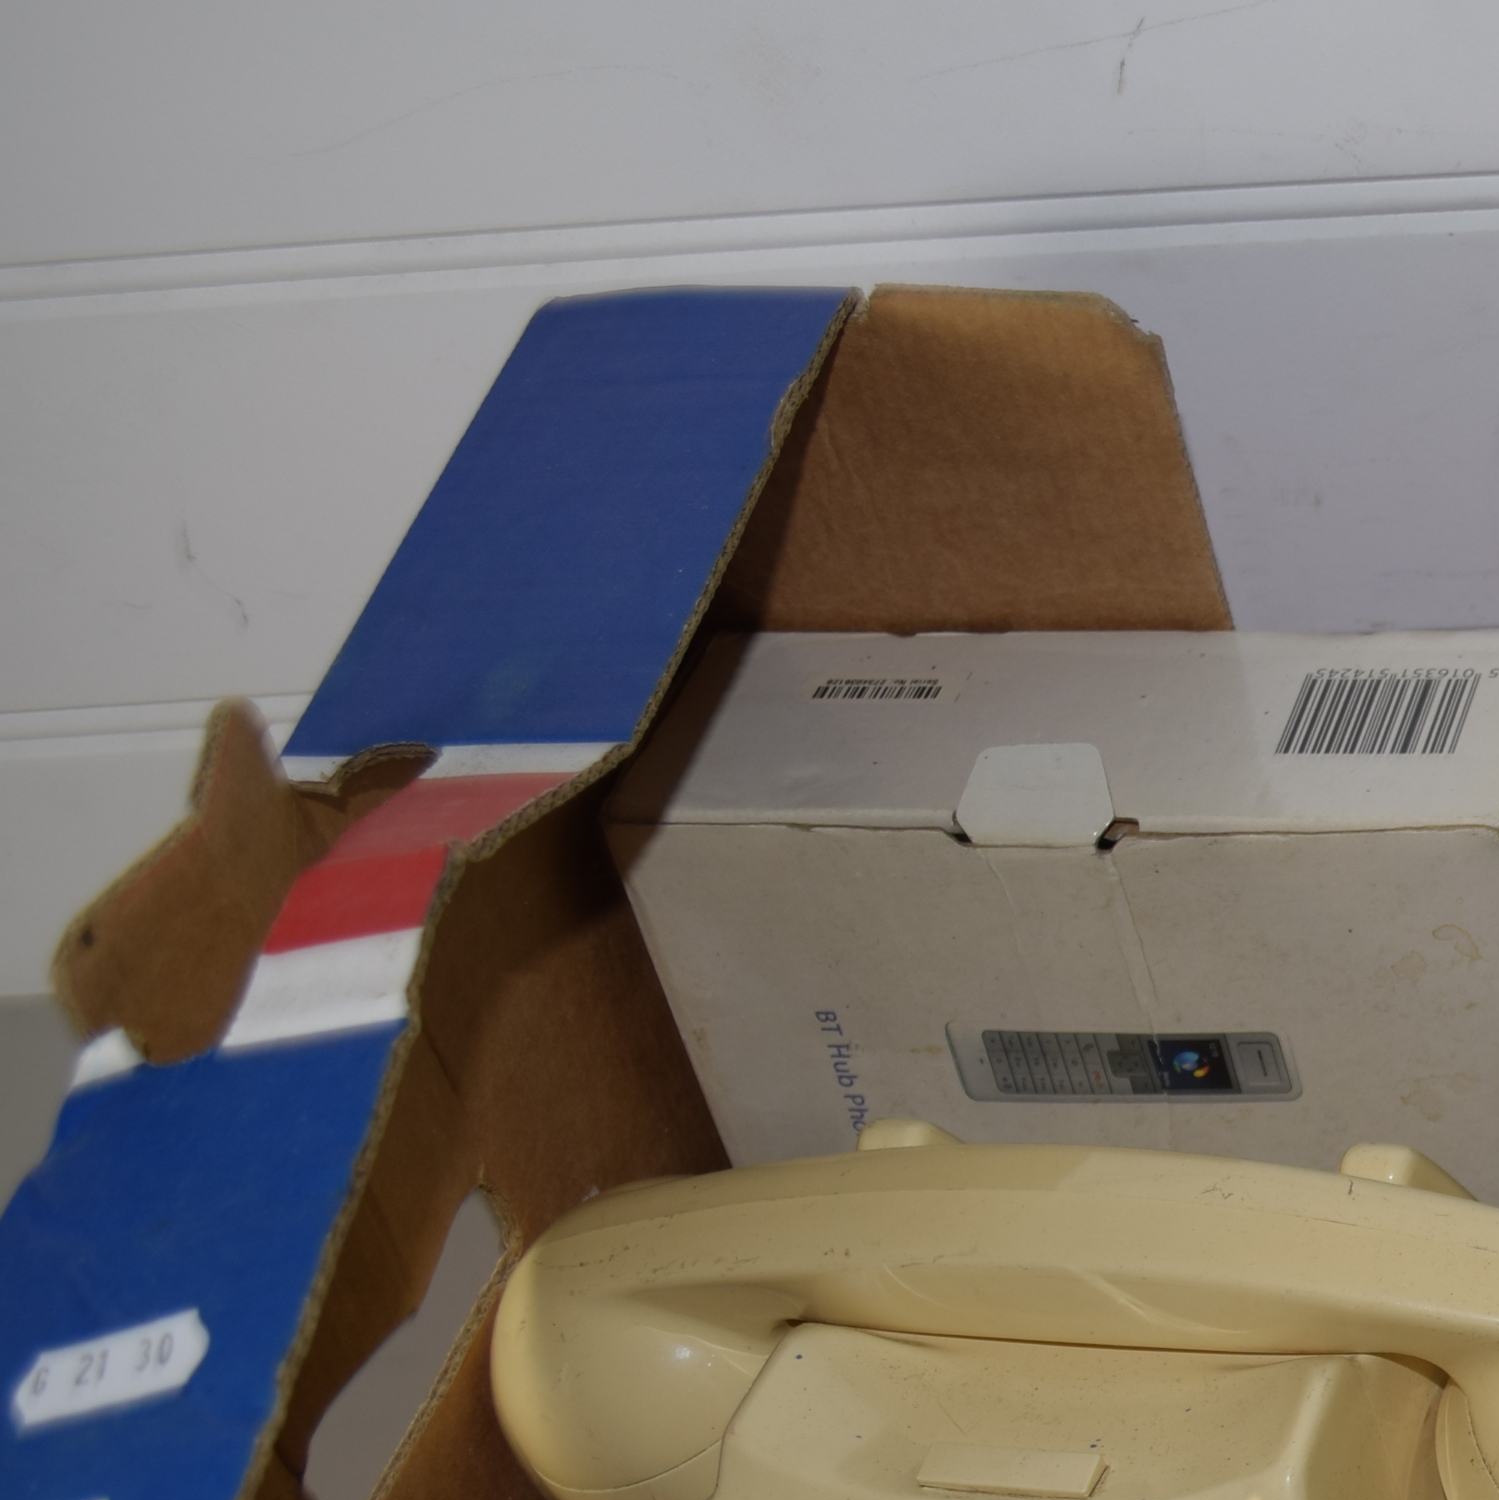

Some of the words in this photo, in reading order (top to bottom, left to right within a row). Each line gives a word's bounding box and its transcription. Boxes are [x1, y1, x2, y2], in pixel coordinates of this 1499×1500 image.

[1315, 668, 1391, 679] 514245
[1400, 668, 1475, 679] 016351
[1489, 668, 1499, 679] 5
[815, 1011, 843, 1036] BT
[827, 1044, 858, 1088] Hub
[843, 1094, 868, 1137] Pho
[135, 1331, 174, 1373] 30
